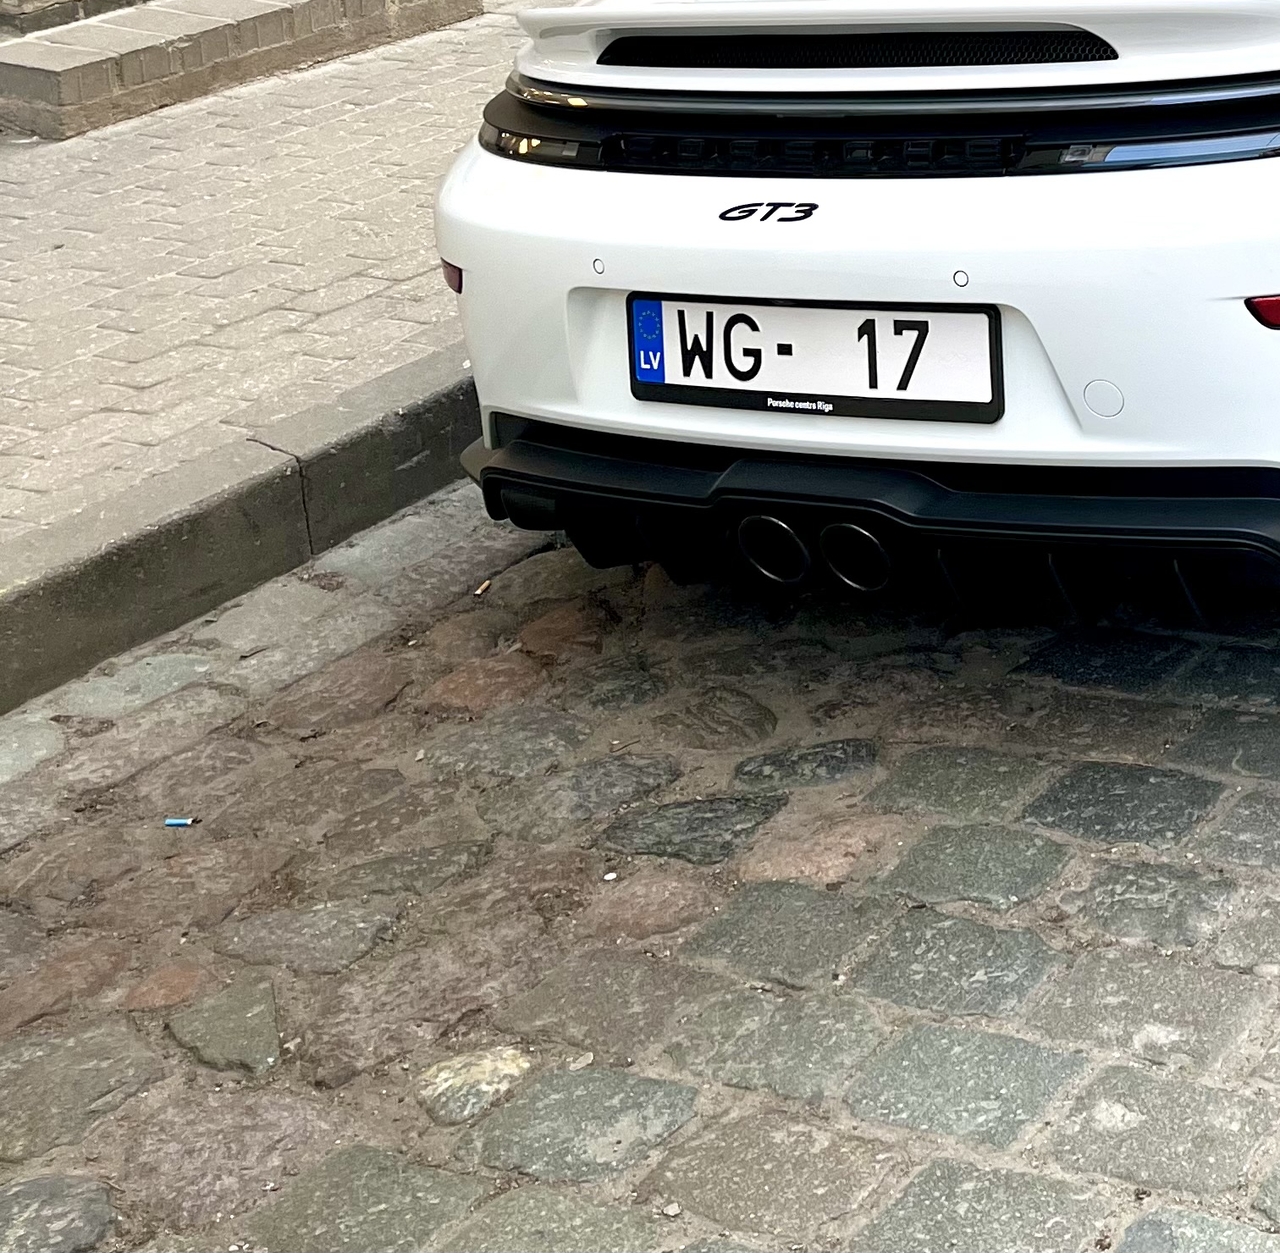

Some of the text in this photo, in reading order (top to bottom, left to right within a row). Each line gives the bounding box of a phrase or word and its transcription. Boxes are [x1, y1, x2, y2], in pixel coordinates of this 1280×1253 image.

[718, 201, 819, 223] GT3
[639, 349, 661, 371] LV
[857, 317, 930, 392] 17
[767, 397, 795, 409] Porsche
